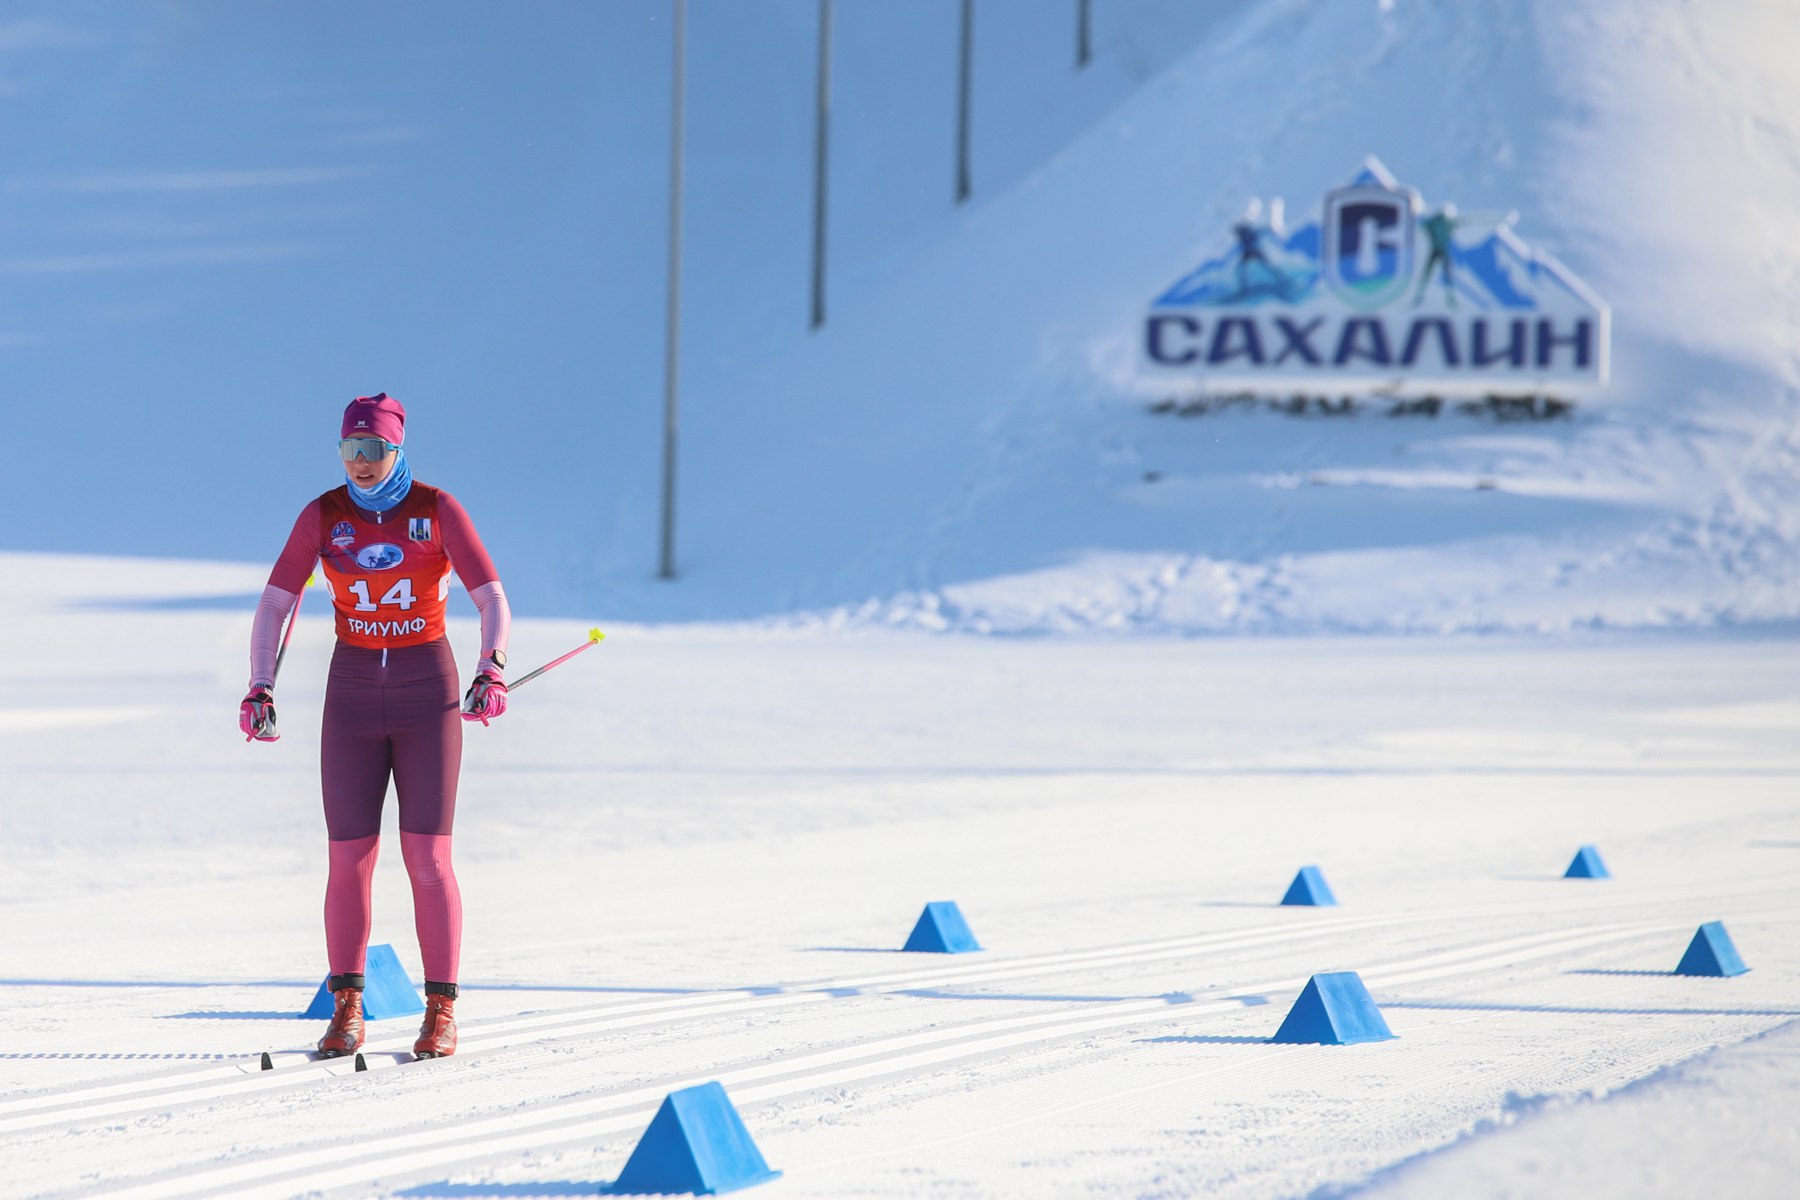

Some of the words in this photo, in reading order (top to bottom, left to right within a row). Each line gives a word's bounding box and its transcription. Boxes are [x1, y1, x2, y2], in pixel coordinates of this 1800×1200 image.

[1145, 314, 1593, 369] САХАЛИН
[347, 577, 418, 612] 14
[347, 616, 426, 637] ТРИУМФ
